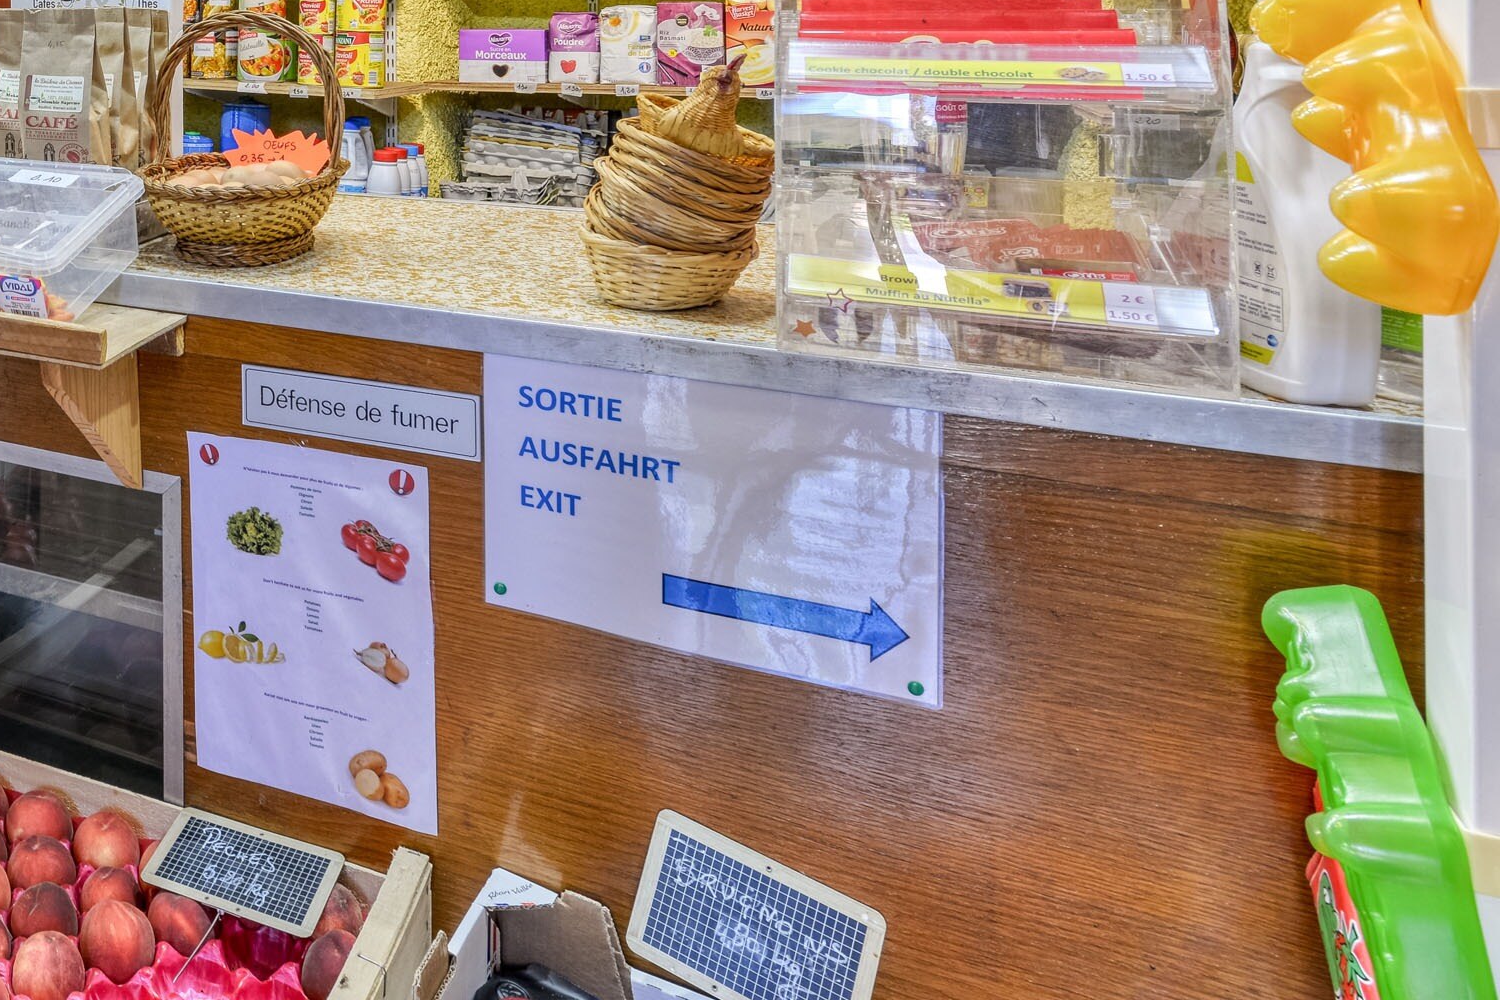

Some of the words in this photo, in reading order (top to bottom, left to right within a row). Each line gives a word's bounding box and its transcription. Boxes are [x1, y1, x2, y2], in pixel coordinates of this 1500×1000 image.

[739, 22, 775, 32] Nature
[553, 38, 584, 47] Poudre
[660, 34, 686, 42] Basmati
[475, 51, 527, 60] Morceaux
[808, 64, 852, 75] Cookie
[854, 66, 909, 76] chocolat
[911, 67, 920, 77] /
[923, 66, 971, 77] double
[974, 67, 1034, 79] chocolat
[1125, 72, 1157, 83] 1.50
[1161, 72, 1172, 82] €
[936, 103, 958, 112] GOÛT
[25, 114, 79, 129] CAFÉ
[262, 140, 298, 152] OEUFS
[4, 280, 34, 294] VIDAL
[865, 286, 910, 300] Muffin
[912, 292, 930, 301] au
[1122, 294, 1130, 304] 2
[1132, 295, 1144, 304] €
[1109, 311, 1141, 322] 1.50
[1144, 312, 1154, 322] €
[518, 384, 623, 423] SORTIE
[260, 385, 347, 418] Défense
[355, 399, 382, 423] de
[391, 403, 460, 435] fumer
[518, 435, 681, 484] AUSFAHRT
[520, 485, 582, 517] EXIT
